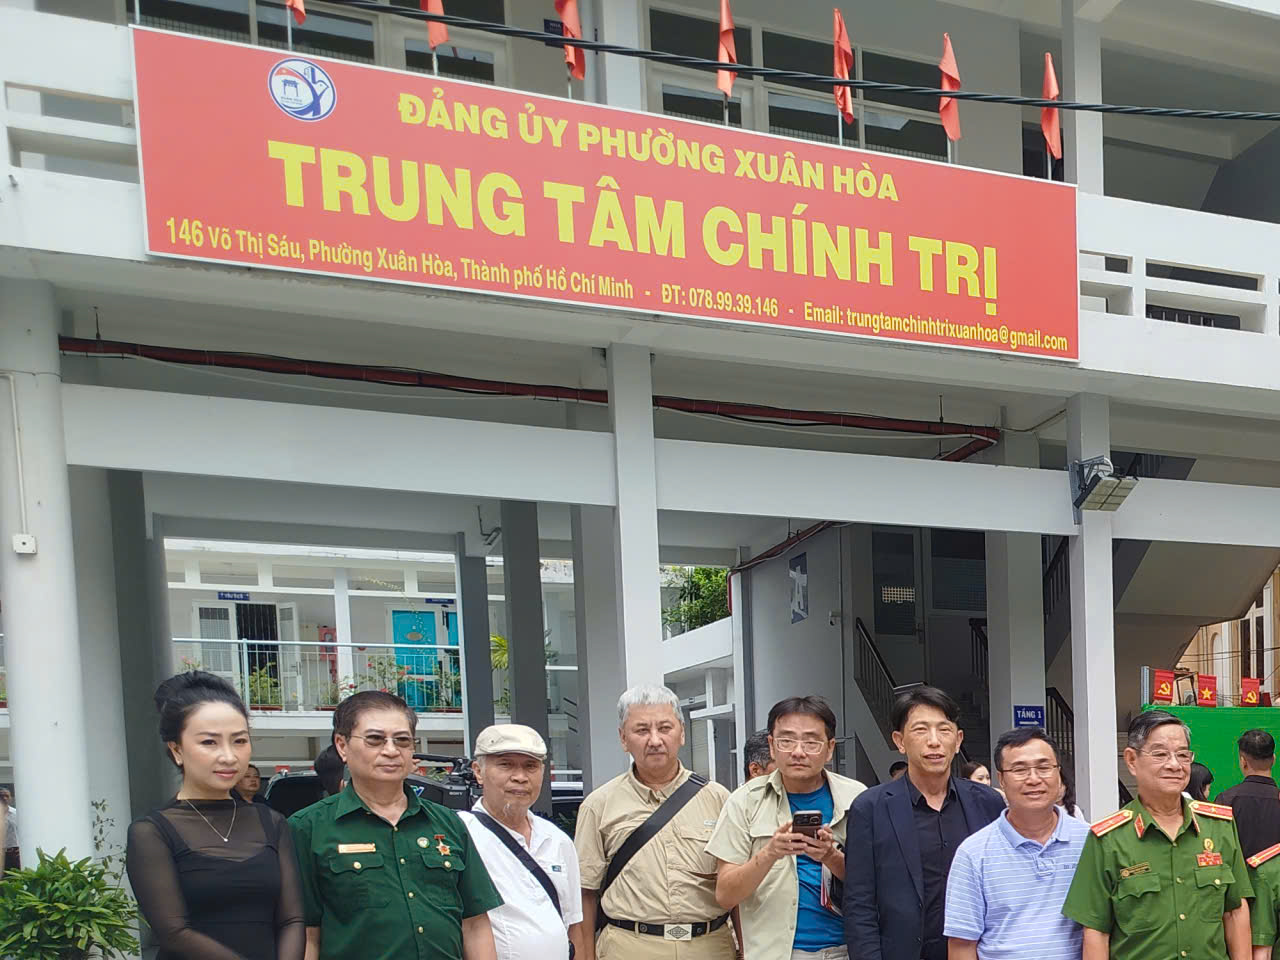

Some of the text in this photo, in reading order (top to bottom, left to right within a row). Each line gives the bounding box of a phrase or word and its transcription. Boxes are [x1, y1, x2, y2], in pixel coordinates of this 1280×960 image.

[397, 88, 899, 201] ĐẢNG ỦY PHƯỜNG XUÂN HÒA
[166, 216, 204, 248] 146
[207, 226, 232, 251] Võ
[234, 229, 264, 260] Thị
[267, 233, 305, 264] Sáu,
[309, 239, 374, 273] Phường
[376, 247, 418, 273] Xuân
[421, 252, 458, 281] Hòa,
[460, 257, 510, 284] Thành
[513, 264, 543, 290] phố
[546, 266, 568, 291] Hồ
[570, 271, 596, 296] Chí
[598, 275, 634, 299] Minh
[661, 283, 686, 305] ĐT:
[688, 287, 779, 317] 078.99.39.146
[804, 301, 844, 325] Email:
[846, 307, 1069, 352] trungtamchinhtrixuanhoa@gmail.com
[267, 139, 998, 316] TRUNG TÂM CHÍNH TRỊ
[1037, 710, 1042, 718] 1
